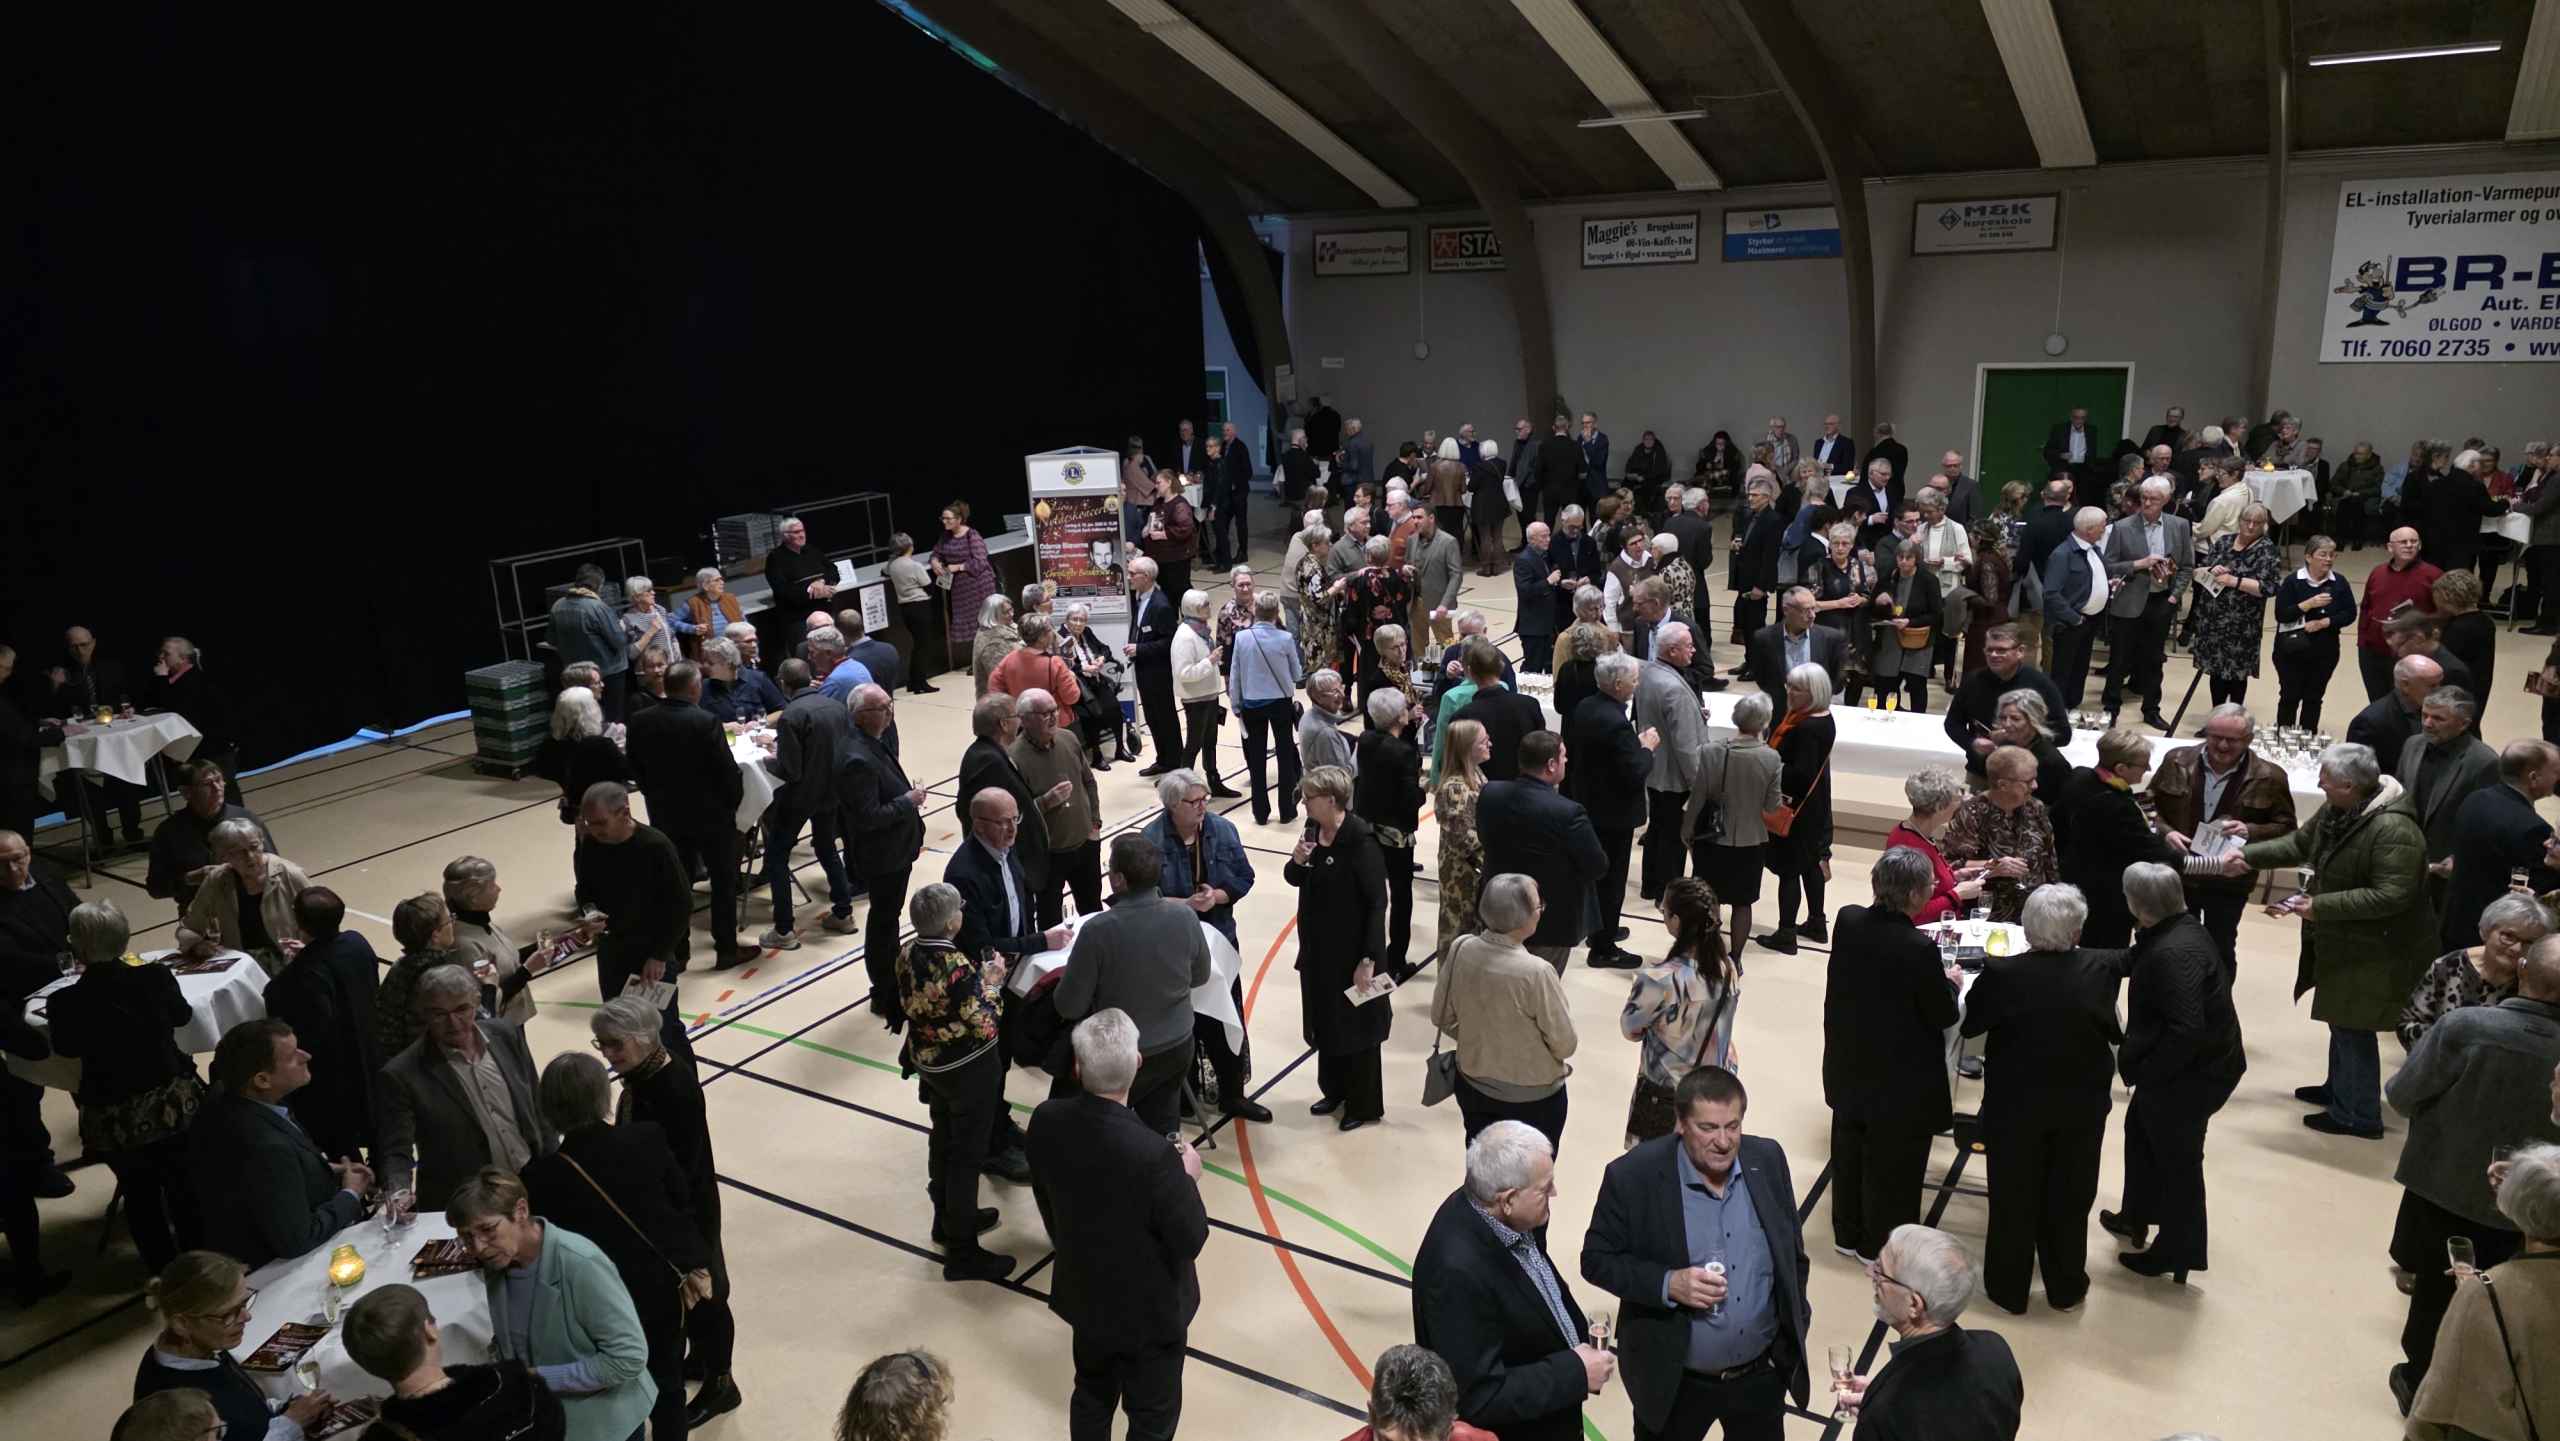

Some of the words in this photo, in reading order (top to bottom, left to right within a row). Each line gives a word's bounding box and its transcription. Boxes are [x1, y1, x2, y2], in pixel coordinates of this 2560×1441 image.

[2406, 208, 2516, 229] Tyverialarmer
[2520, 209, 2540, 225] og
[1587, 221, 1638, 247] Maggie's
[2480, 296, 2529, 311] Aut.
[2428, 317, 2482, 331] ØLGOD
[2341, 339, 2371, 357] Tlf.
[2380, 340, 2431, 357] 7060
[2437, 339, 2490, 356] 2735
